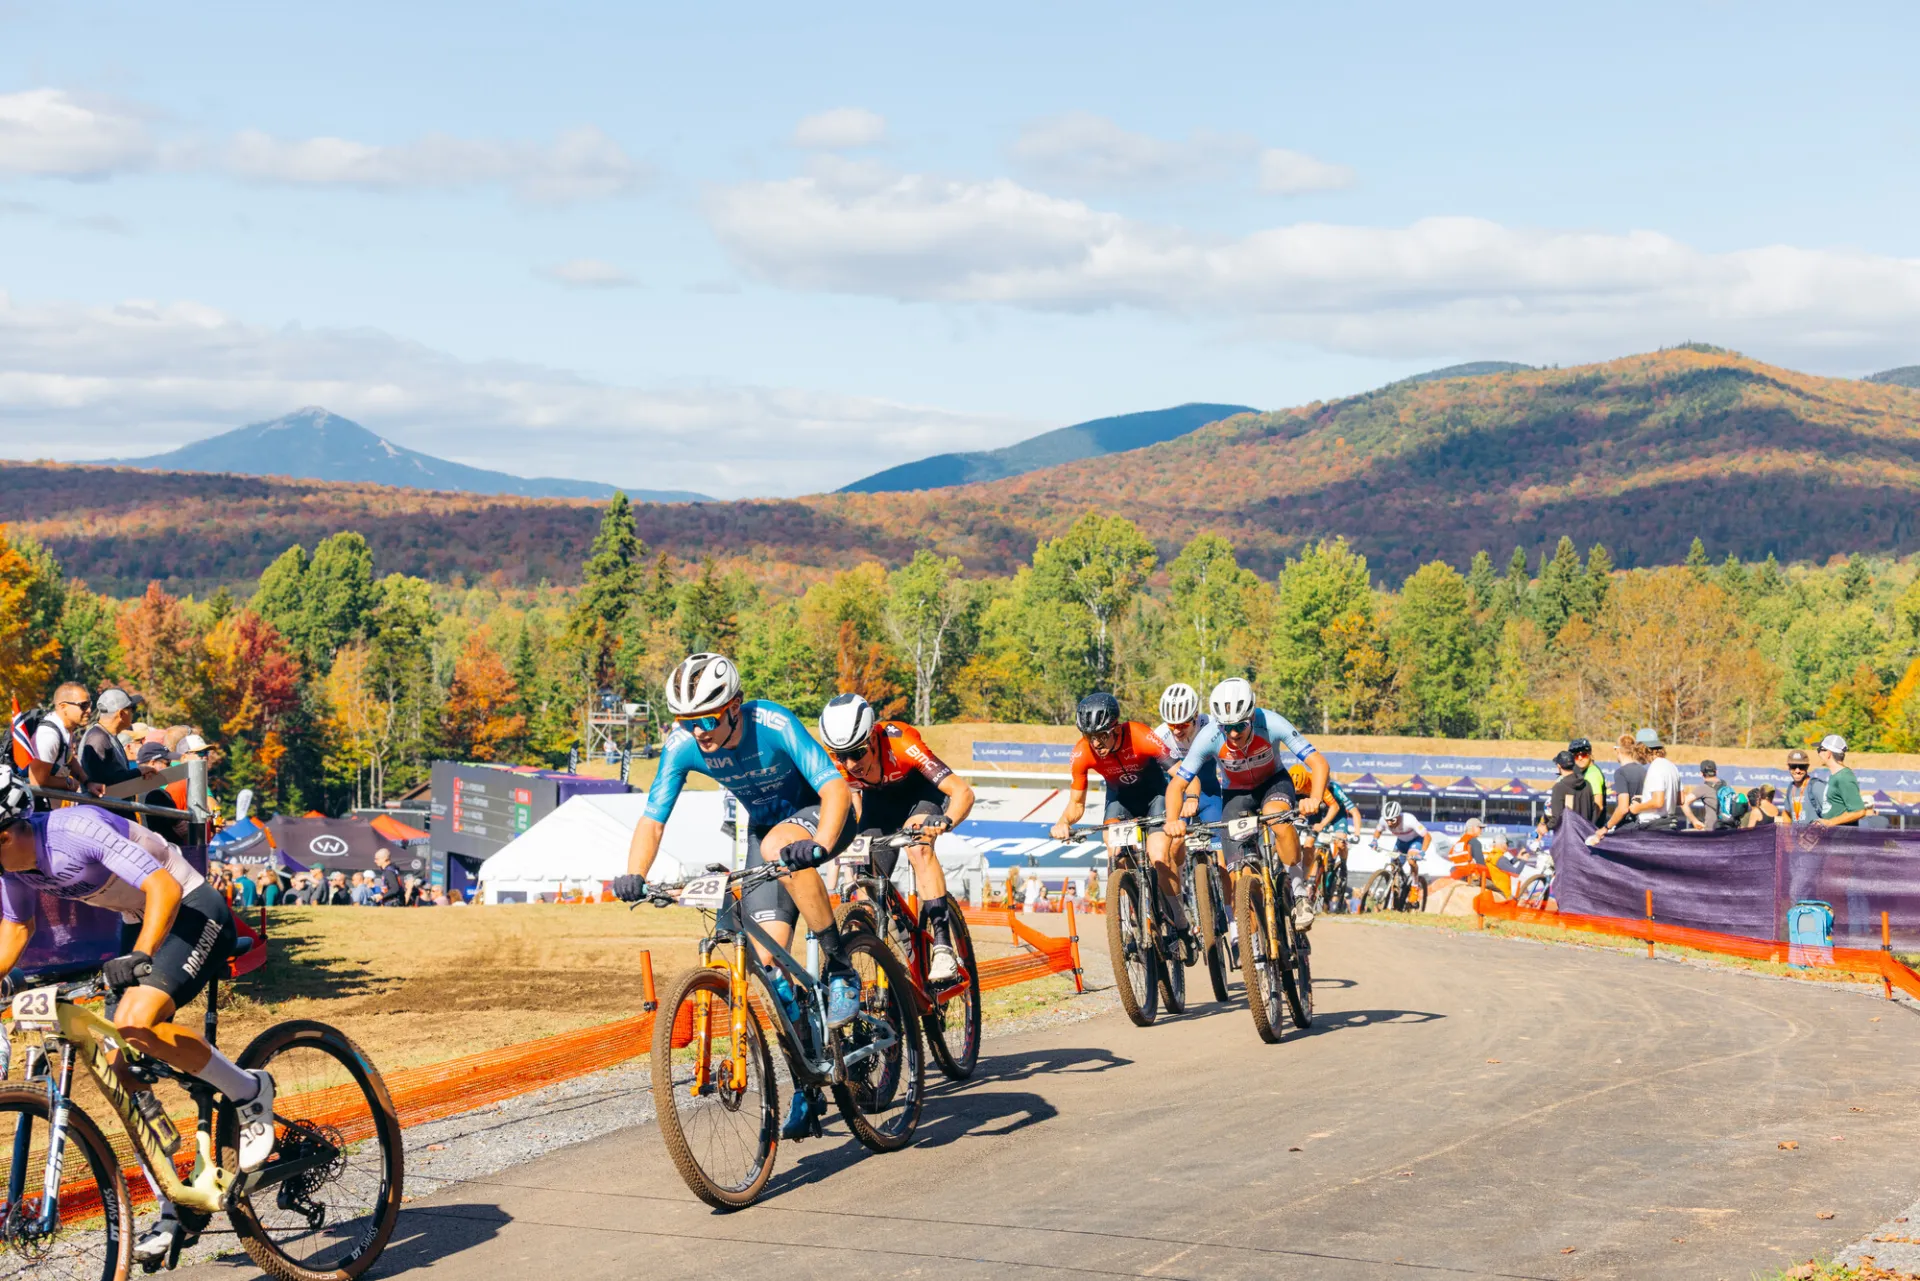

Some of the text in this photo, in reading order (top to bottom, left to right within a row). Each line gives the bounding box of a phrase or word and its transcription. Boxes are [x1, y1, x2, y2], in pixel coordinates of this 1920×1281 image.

[905, 744, 938, 771] BMC
[932, 767, 950, 783] BOSS
[1236, 818, 1248, 830] 6
[688, 880, 719, 895] 28
[19, 993, 49, 1016] 23
[103, 1188, 119, 1221] SWISS
[351, 1225, 379, 1261] DT SWISS
